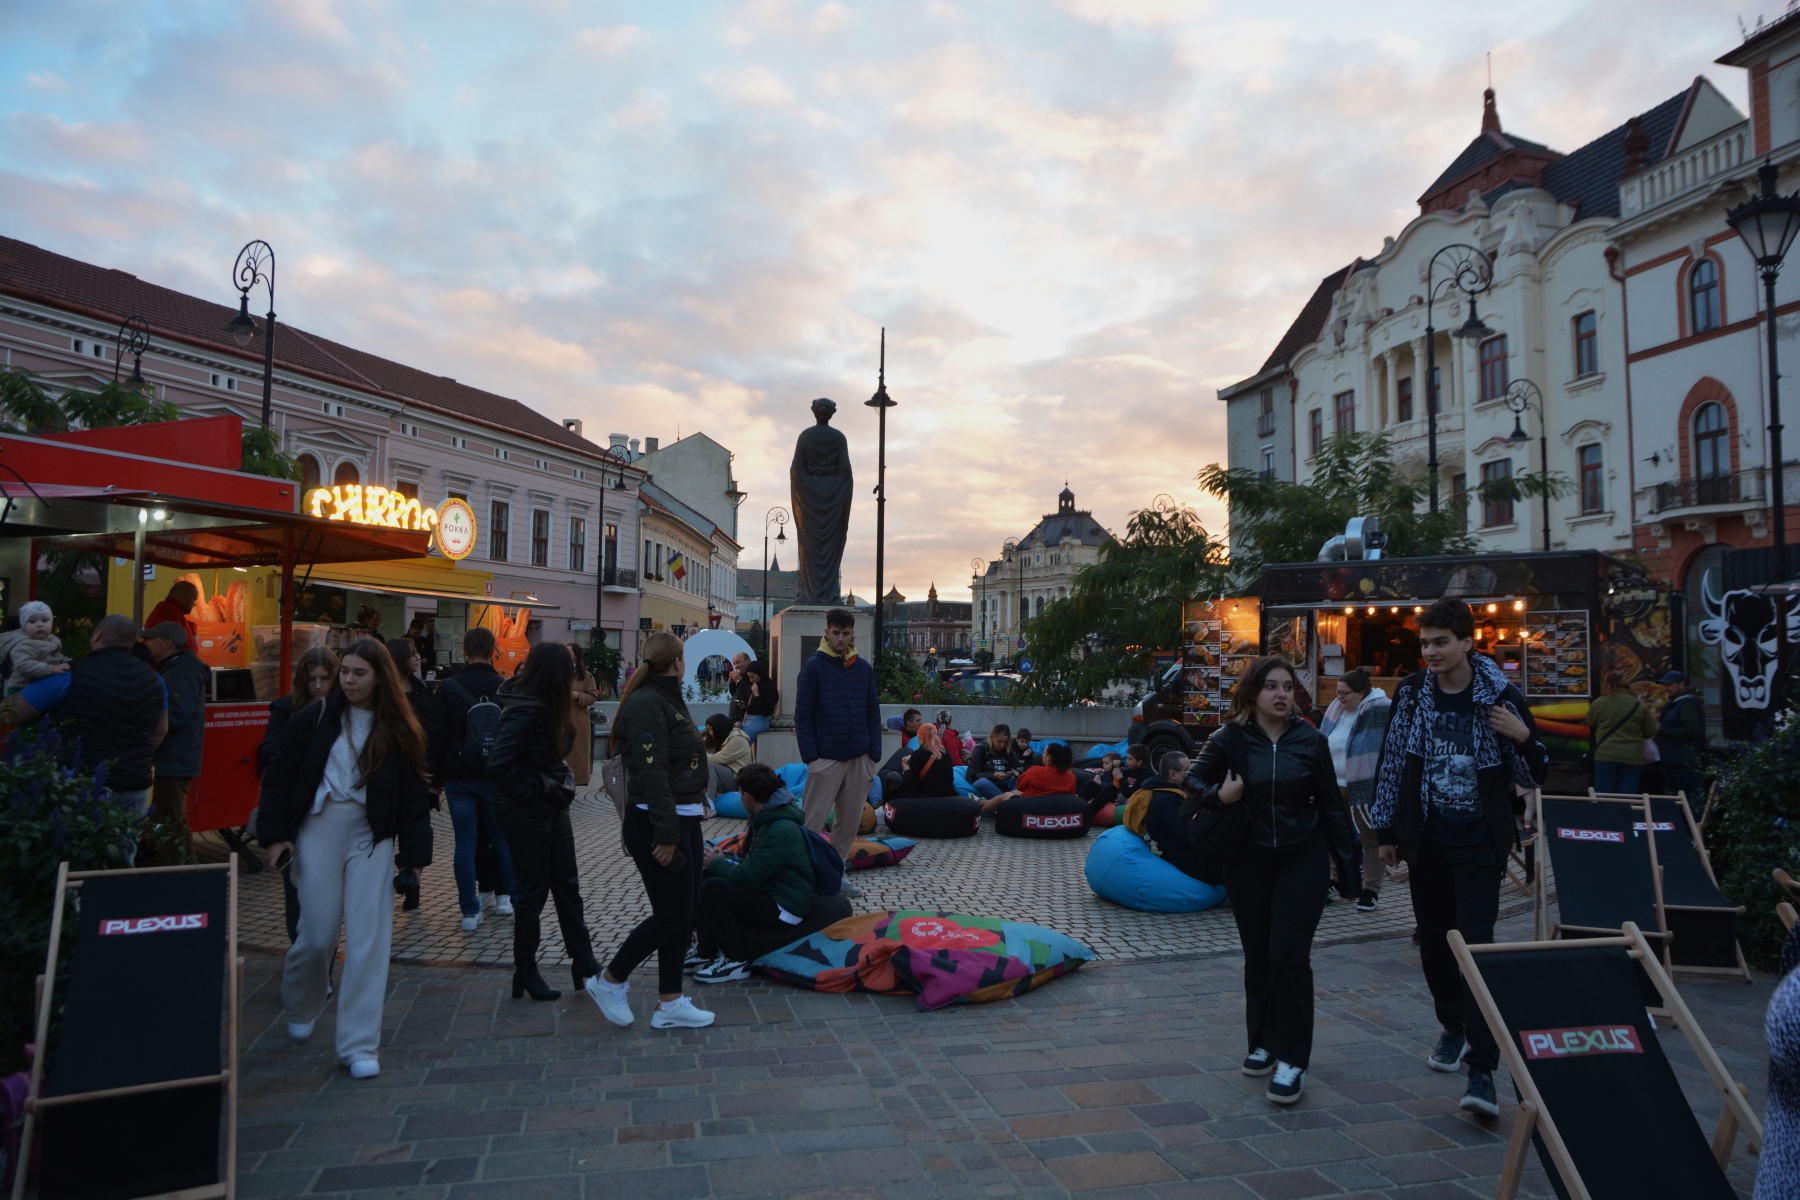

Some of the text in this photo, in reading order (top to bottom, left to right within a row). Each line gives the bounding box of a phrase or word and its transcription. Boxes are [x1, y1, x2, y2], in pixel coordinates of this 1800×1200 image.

[312, 484, 438, 547] CHURROS
[444, 523, 469, 535] POKKA
[1026, 815, 1081, 828] PLEXUS
[1561, 829, 1620, 841] PLEXUS
[105, 914, 203, 936] PLEXUS
[1527, 1028, 1635, 1056] PLEXUS
